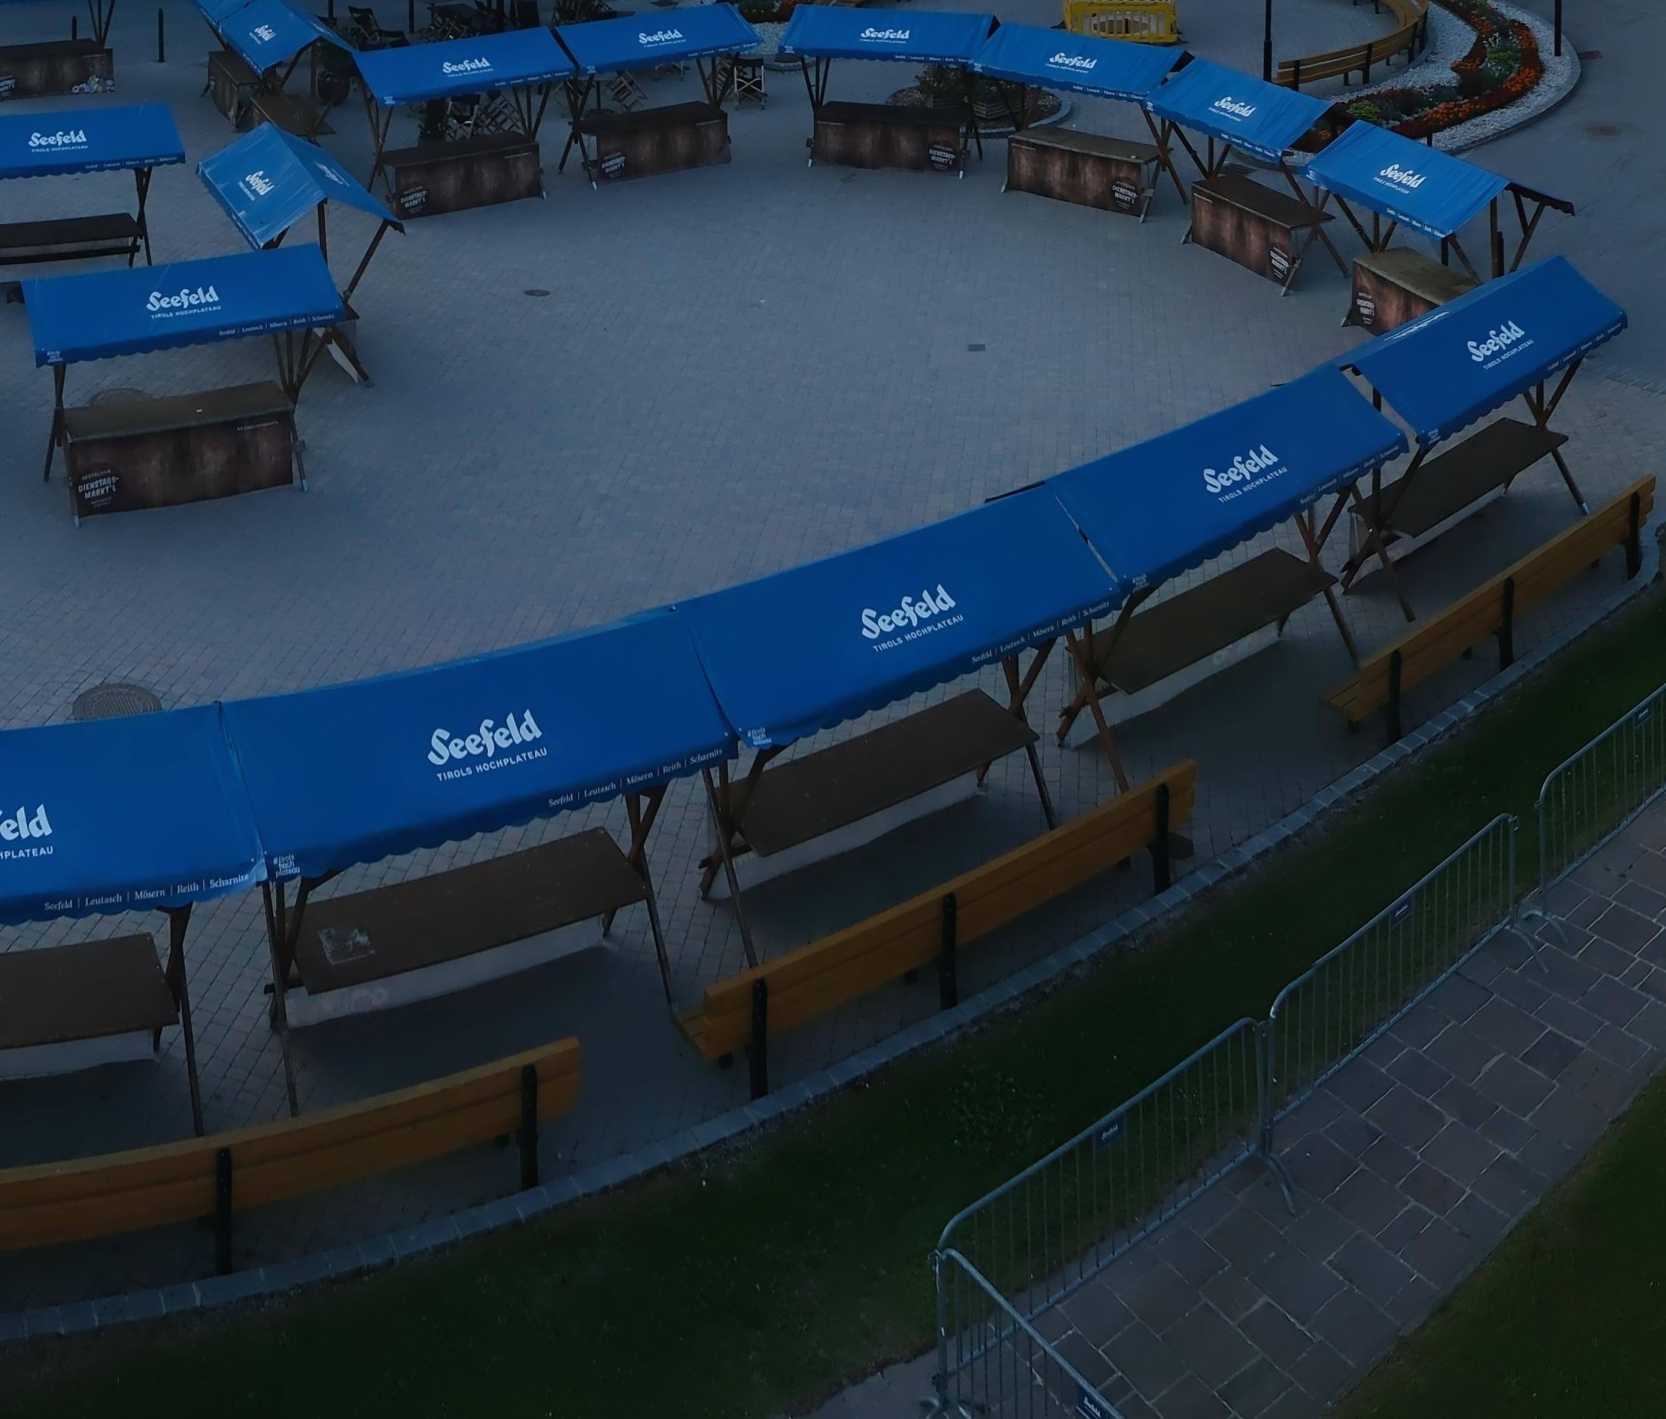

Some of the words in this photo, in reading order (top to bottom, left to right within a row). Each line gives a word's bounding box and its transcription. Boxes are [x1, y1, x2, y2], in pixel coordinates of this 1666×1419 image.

[637, 28, 684, 45] Seefeld
[859, 27, 911, 41] Seefeld
[442, 56, 491, 75] Seefeld
[1049, 51, 1098, 70] Seefeld
[1214, 95, 1258, 118] Seefeld
[27, 129, 88, 151] Seefeld
[1379, 163, 1427, 190] Seefeld
[145, 284, 220, 313] Seefeld
[1467, 320, 1526, 362] Seefeld
[1202, 443, 1280, 494] Seefeld
[861, 583, 958, 640] Seefeld
[872, 637, 904, 653] TIROLS
[905, 613, 965, 642] HOCHPLATEAU
[427, 708, 544, 766] Seefeld
[437, 767, 473, 782] TIROLS
[475, 747, 549, 774] HOCHPLATEAU
[548, 789, 575, 808] Seefeld
[583, 780, 618, 799] Leutasch
[626, 770, 654, 787] Mösern
[662, 760, 683, 775] Reith
[689, 747, 725, 766] Scharnitz
[44, 898, 74, 911] Seefeld
[85, 893, 124, 907] Leutasch
[134, 889, 167, 900] Mösern
[176, 883, 200, 894] Reith
[209, 873, 250, 889] Scharnitz
